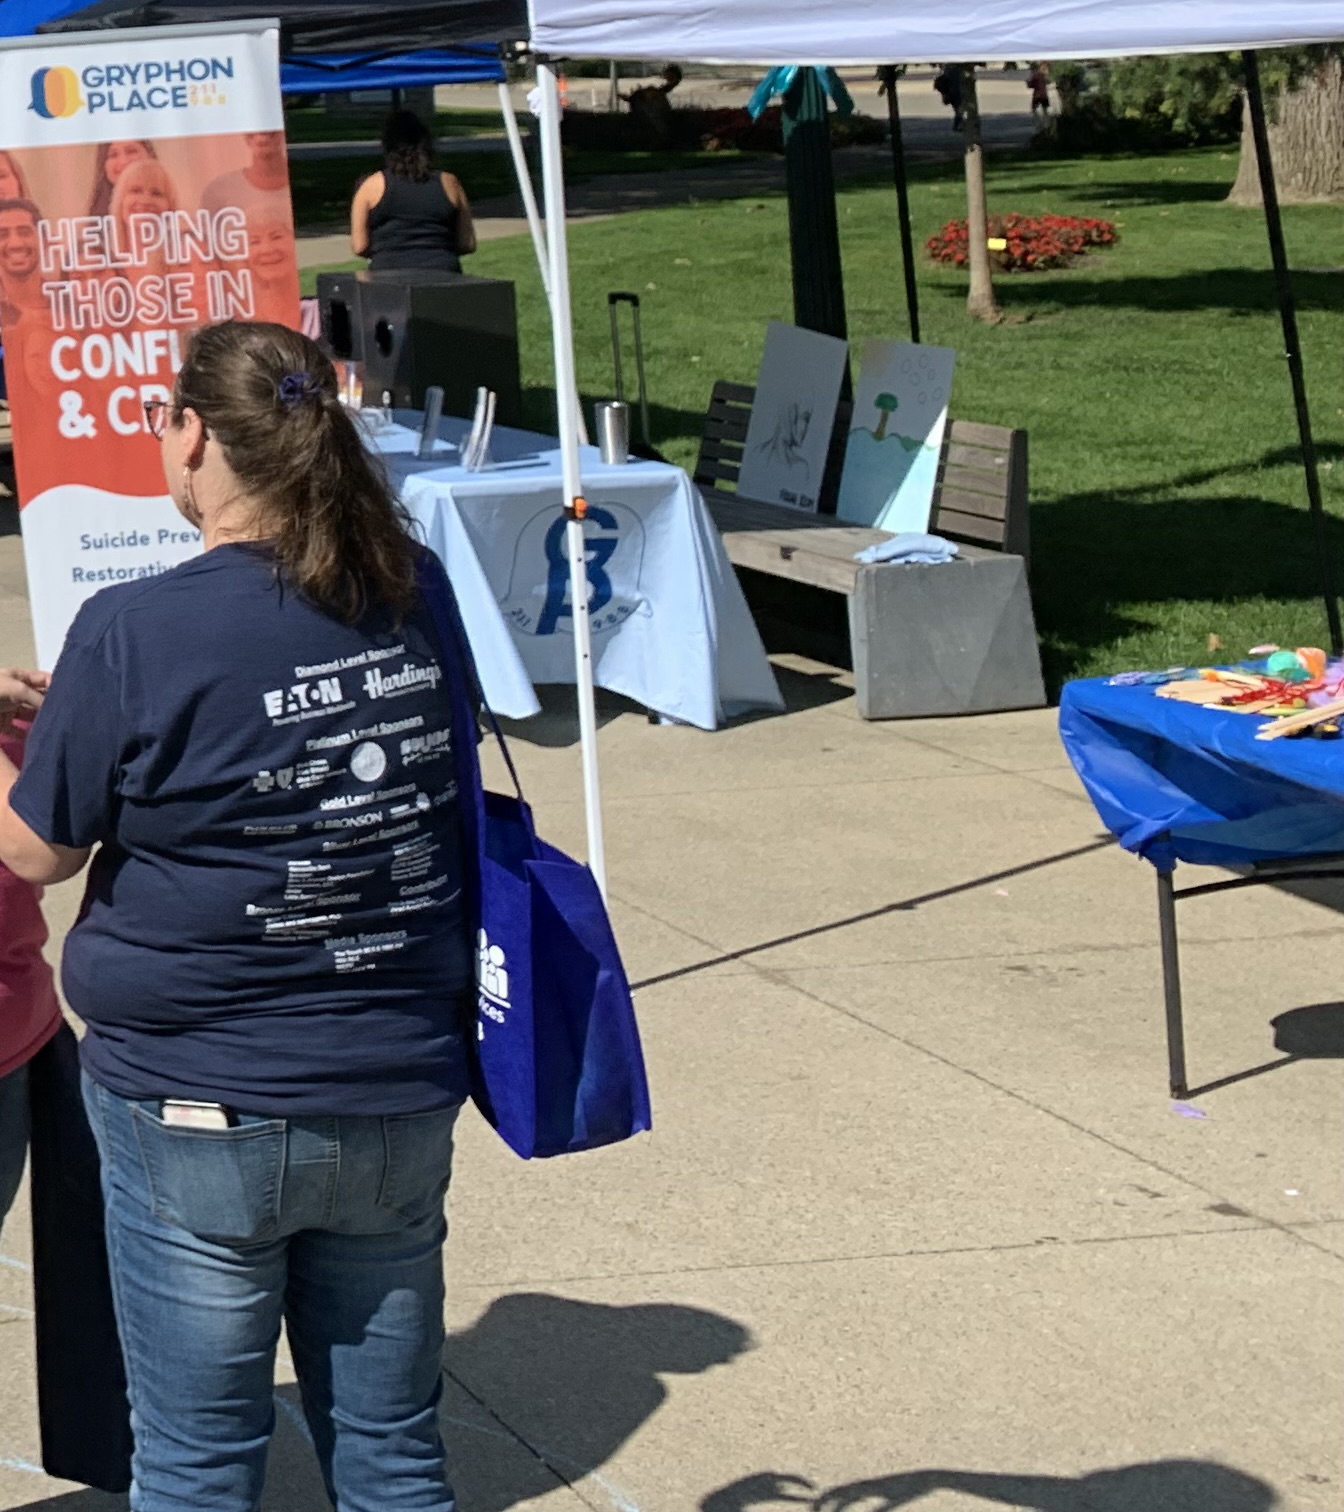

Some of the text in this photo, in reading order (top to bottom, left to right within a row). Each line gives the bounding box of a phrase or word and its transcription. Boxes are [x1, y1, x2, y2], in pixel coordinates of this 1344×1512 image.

[81, 56, 234, 88] GRYPHON
[87, 85, 188, 113] PLACE
[37, 206, 249, 273] HELPING
[42, 268, 255, 330] THOSE IN
[58, 390, 97, 438] &
[80, 530, 150, 550] Suicide
